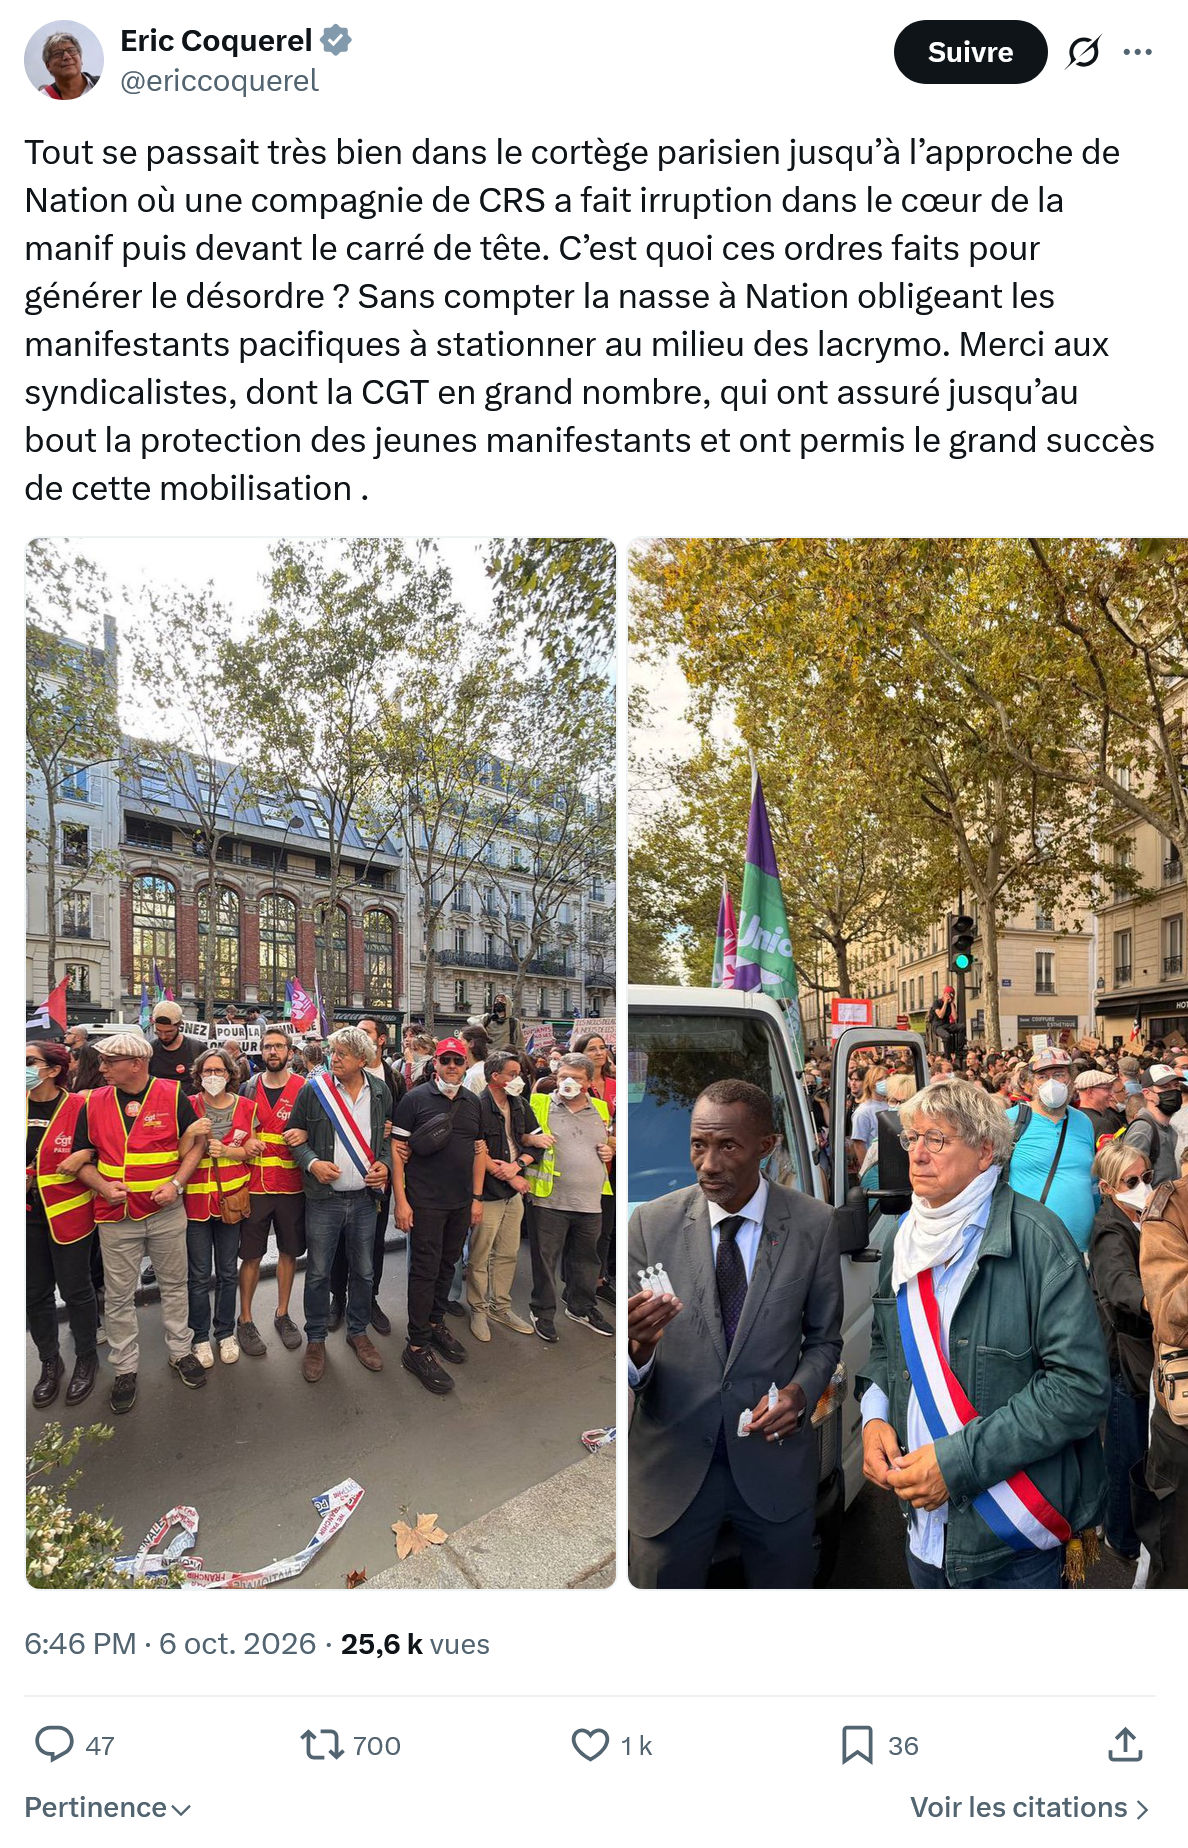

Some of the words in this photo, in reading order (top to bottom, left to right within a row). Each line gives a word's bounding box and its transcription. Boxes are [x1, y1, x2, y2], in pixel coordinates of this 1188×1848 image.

[122, 27, 175, 52] Eric
[182, 27, 312, 58] Coquerel
[928, 39, 1014, 63] Suivre
[121, 67, 320, 98] @ericcoquerel
[23, 139, 94, 165] Tout
[102, 145, 137, 165] se
[147, 137, 260, 172] passait
[266, 136, 327, 165] très
[337, 137, 402, 165] bien
[411, 137, 487, 165] dans
[497, 137, 523, 165] le
[531, 136, 649, 172] cortège
[658, 137, 780, 172] parisien
[1081, 137, 1120, 165] de
[26, 185, 128, 213] Nation
[137, 184, 175, 213] où
[185, 193, 243, 213] une
[251, 185, 424, 220] compagnie
[432, 185, 471, 213] de
[479, 187, 546, 213] CRS
[554, 193, 572, 213] a
[579, 185, 632, 213] fait
[640, 185, 772, 220] irruption
[781, 185, 857, 213] dans
[867, 185, 893, 213] le
[901, 193, 983, 213] cœur
[990, 185, 1029, 213] de
[1038, 185, 1064, 213] la
[25, 233, 114, 261] manif
[122, 233, 187, 268] puis
[195, 233, 303, 261] devant
[312, 233, 337, 261] le
[346, 232, 425, 261] carré
[433, 233, 472, 261] de
[479, 232, 549, 261] tête.
[645, 233, 713, 268] quoi
[722, 241, 775, 261] ces
[784, 233, 883, 261] ordres
[890, 233, 960, 261] faits
[969, 241, 1041, 268] pour
[24, 280, 143, 316] générer
[152, 281, 177, 309] le
[186, 280, 325, 309] désordre
[332, 283, 350, 309] ?
[358, 283, 435, 309] Sans
[444, 284, 576, 316] compter
[584, 281, 609, 309] la
[619, 289, 710, 309] nasse
[718, 280, 736, 309] à
[746, 281, 848, 309] Nation
[857, 281, 1003, 316] obligeant
[1012, 281, 1055, 309] les
[25, 329, 230, 357] manifestants
[239, 329, 401, 364] pacifiques
[409, 328, 427, 357] à
[436, 329, 597, 357] stationner
[605, 337, 642, 357] au
[652, 329, 744, 357] milieu
[753, 329, 809, 357] des
[818, 329, 950, 364] lacrymo.
[960, 330, 1044, 357] Merci
[1054, 337, 1110, 357] aux
[24, 377, 237, 412] syndicalistes,
[246, 377, 319, 405] dont
[327, 377, 353, 405] la
[362, 379, 430, 405] CGT
[438, 385, 475, 405] en
[484, 377, 572, 412] grand
[583, 377, 710, 410] nombre,
[720, 378, 767, 412] qui
[776, 380, 829, 405] ont
[837, 376, 940, 405] assuré
[25, 425, 97, 453] bout
[106, 425, 131, 453] la
[141, 426, 301, 460] protection
[310, 425, 366, 453] des
[372, 425, 477, 460] jeunes
[487, 425, 691, 453] manifestants
[700, 428, 731, 453] et
[739, 428, 792, 453] ont
[800, 425, 905, 460] permis
[915, 425, 941, 453] le
[948, 425, 1036, 460] grand
[1046, 424, 1155, 453] succès
[24, 473, 63, 501] de
[71, 476, 151, 501] cette
[160, 473, 351, 501] mobilisation
[217, 1027, 246, 1037] POUR
[248, 1027, 260, 1037] LA
[186, 1572, 226, 1582] FRANCHIR
[25, 1632, 86, 1655] 6:46
[94, 1632, 136, 1655] PM
[159, 1632, 177, 1655] 6
[184, 1632, 236, 1655] oct.
[244, 1632, 316, 1655] 2026
[341, 1633, 401, 1659] 25,6
[407, 1632, 424, 1655] k
[429, 1638, 490, 1655] vues
[85, 1736, 115, 1756] 47
[353, 1736, 401, 1756] 700
[621, 1736, 630, 1756] 1
[640, 1734, 653, 1756] k
[888, 1736, 919, 1756] 36
[25, 1795, 167, 1818] Pertinence
[909, 1795, 963, 1818] Voir
[969, 1795, 1006, 1818] les
[1012, 1795, 1128, 1818] citations
